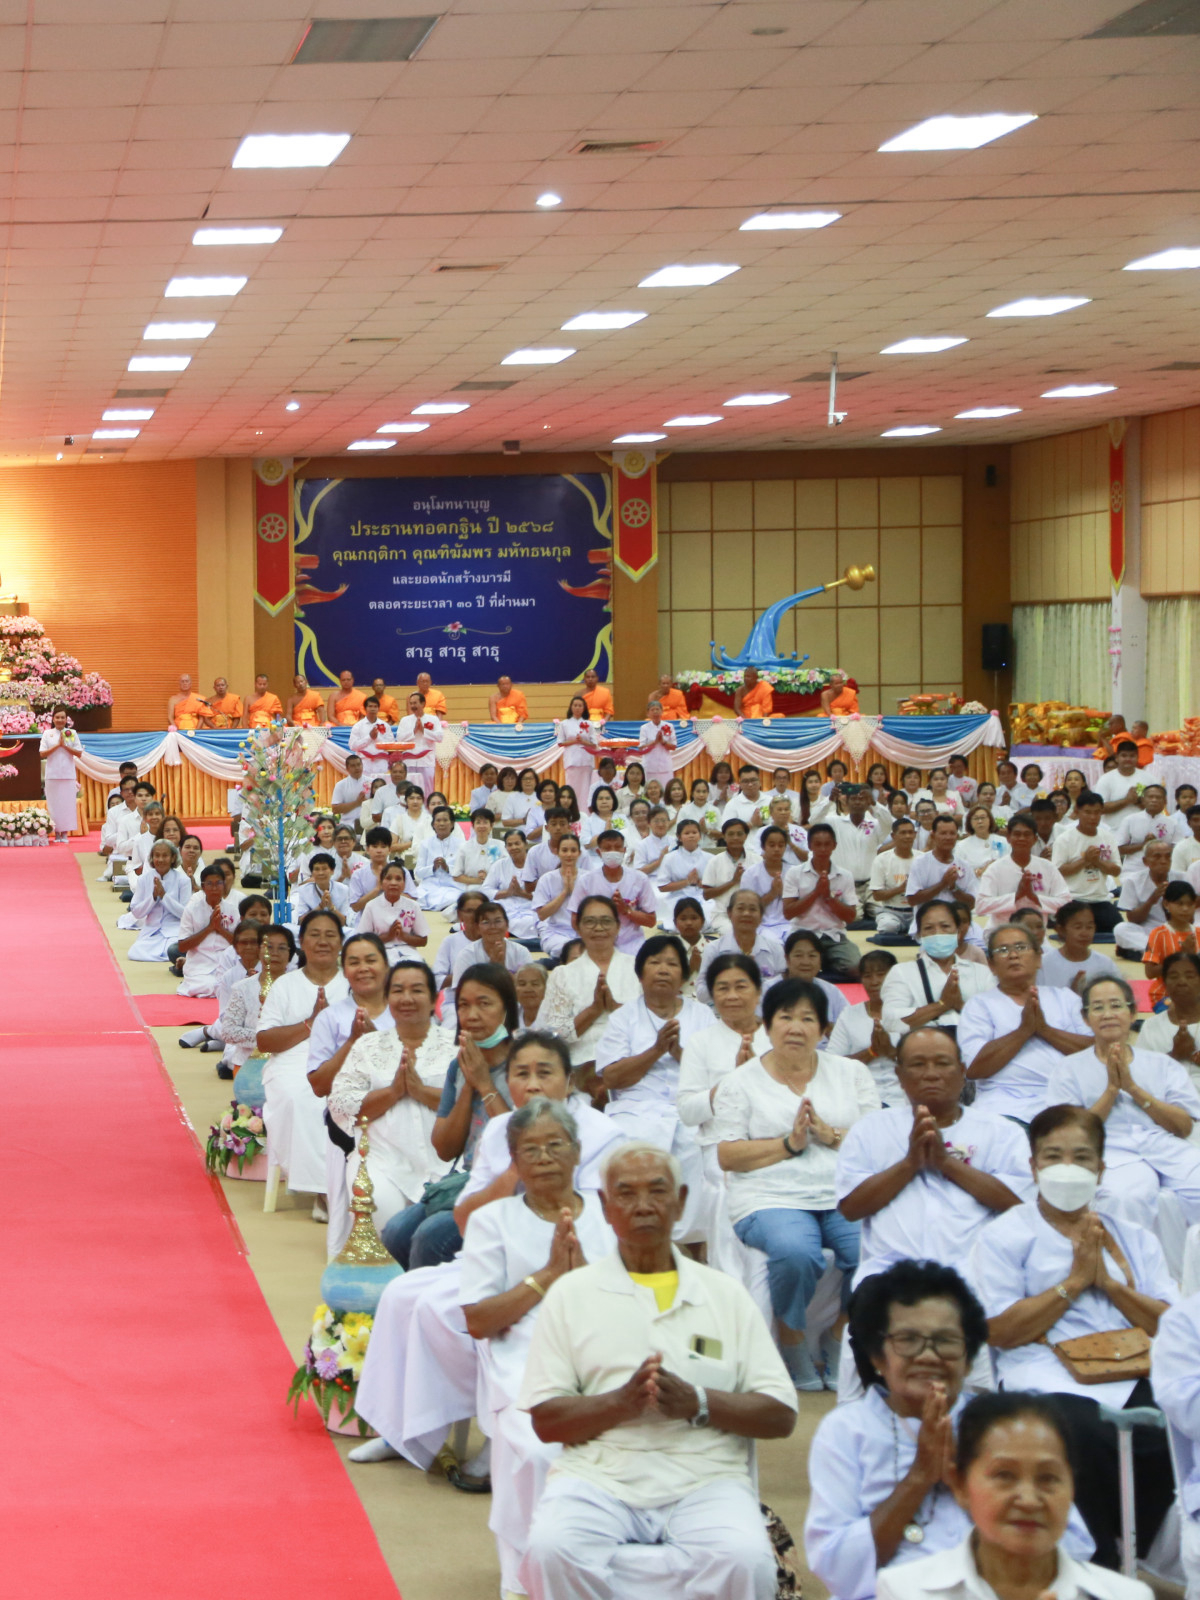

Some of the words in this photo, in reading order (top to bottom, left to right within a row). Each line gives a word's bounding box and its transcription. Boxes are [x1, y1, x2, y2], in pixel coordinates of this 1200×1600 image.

[413, 496, 490, 514] อนุโมทนาบุญ
[350, 518, 482, 540] ประธานทอดกฐิน
[487, 515, 500, 534] ปี
[506, 521, 555, 534] ๒๕๖๘
[392, 570, 511, 585] และยอดนักสร้างบารมี
[368, 598, 453, 610] ตลอดระยะเวลา
[456, 599, 473, 608] ๓๐
[476, 594, 485, 608] ปี
[488, 594, 536, 608] ที่ผ่านมา
[405, 646, 433, 664] สาธุ
[438, 645, 466, 664] สาธุ
[472, 644, 500, 663] สาธุ
